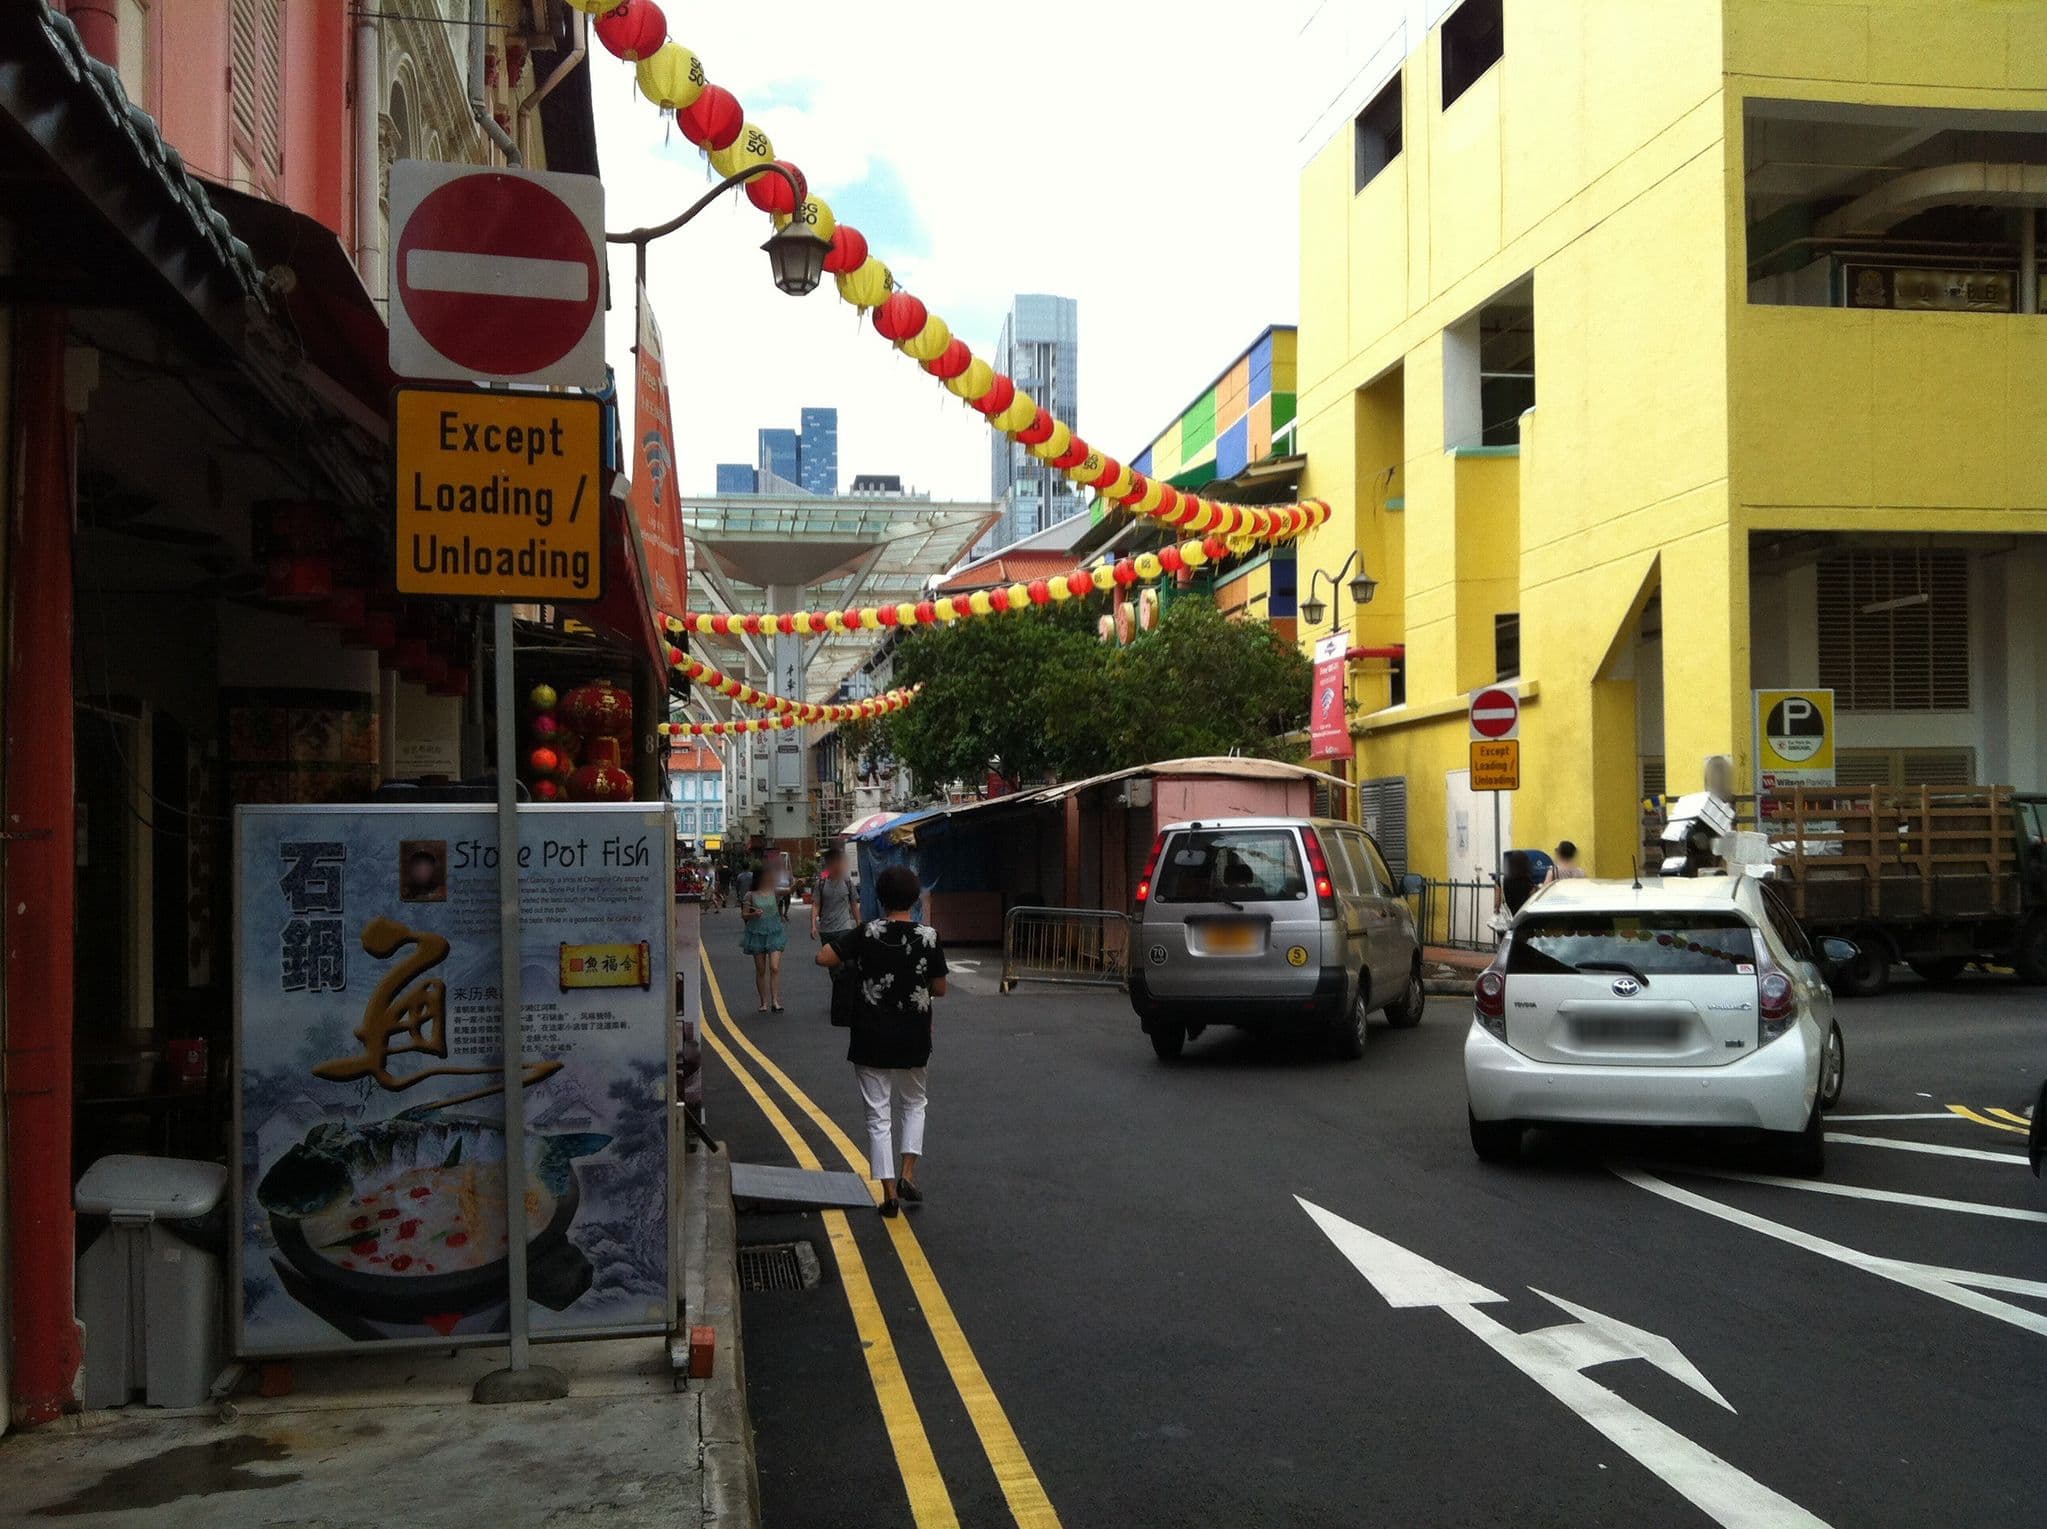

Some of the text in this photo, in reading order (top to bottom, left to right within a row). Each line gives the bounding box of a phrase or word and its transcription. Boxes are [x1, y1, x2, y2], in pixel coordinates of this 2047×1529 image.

[688, 68, 704, 87] 50
[748, 130, 768, 145] SG
[746, 140, 767, 157] 50
[439, 410, 565, 465] Except
[413, 471, 588, 526] Loading /
[412, 534, 590, 590] Unloading
[1783, 699, 1813, 735] P
[645, 734, 655, 753] 8
[1480, 745, 1510, 758] Except
[1475, 760, 1507, 772] Loading
[1474, 775, 1516, 787] Unloading
[1777, 778, 1832, 788] Wilson Parking
[453, 836, 649, 868] Stoe Pot Fish
[1153, 948, 1164, 957] 70
[1293, 949, 1301, 960] 5
